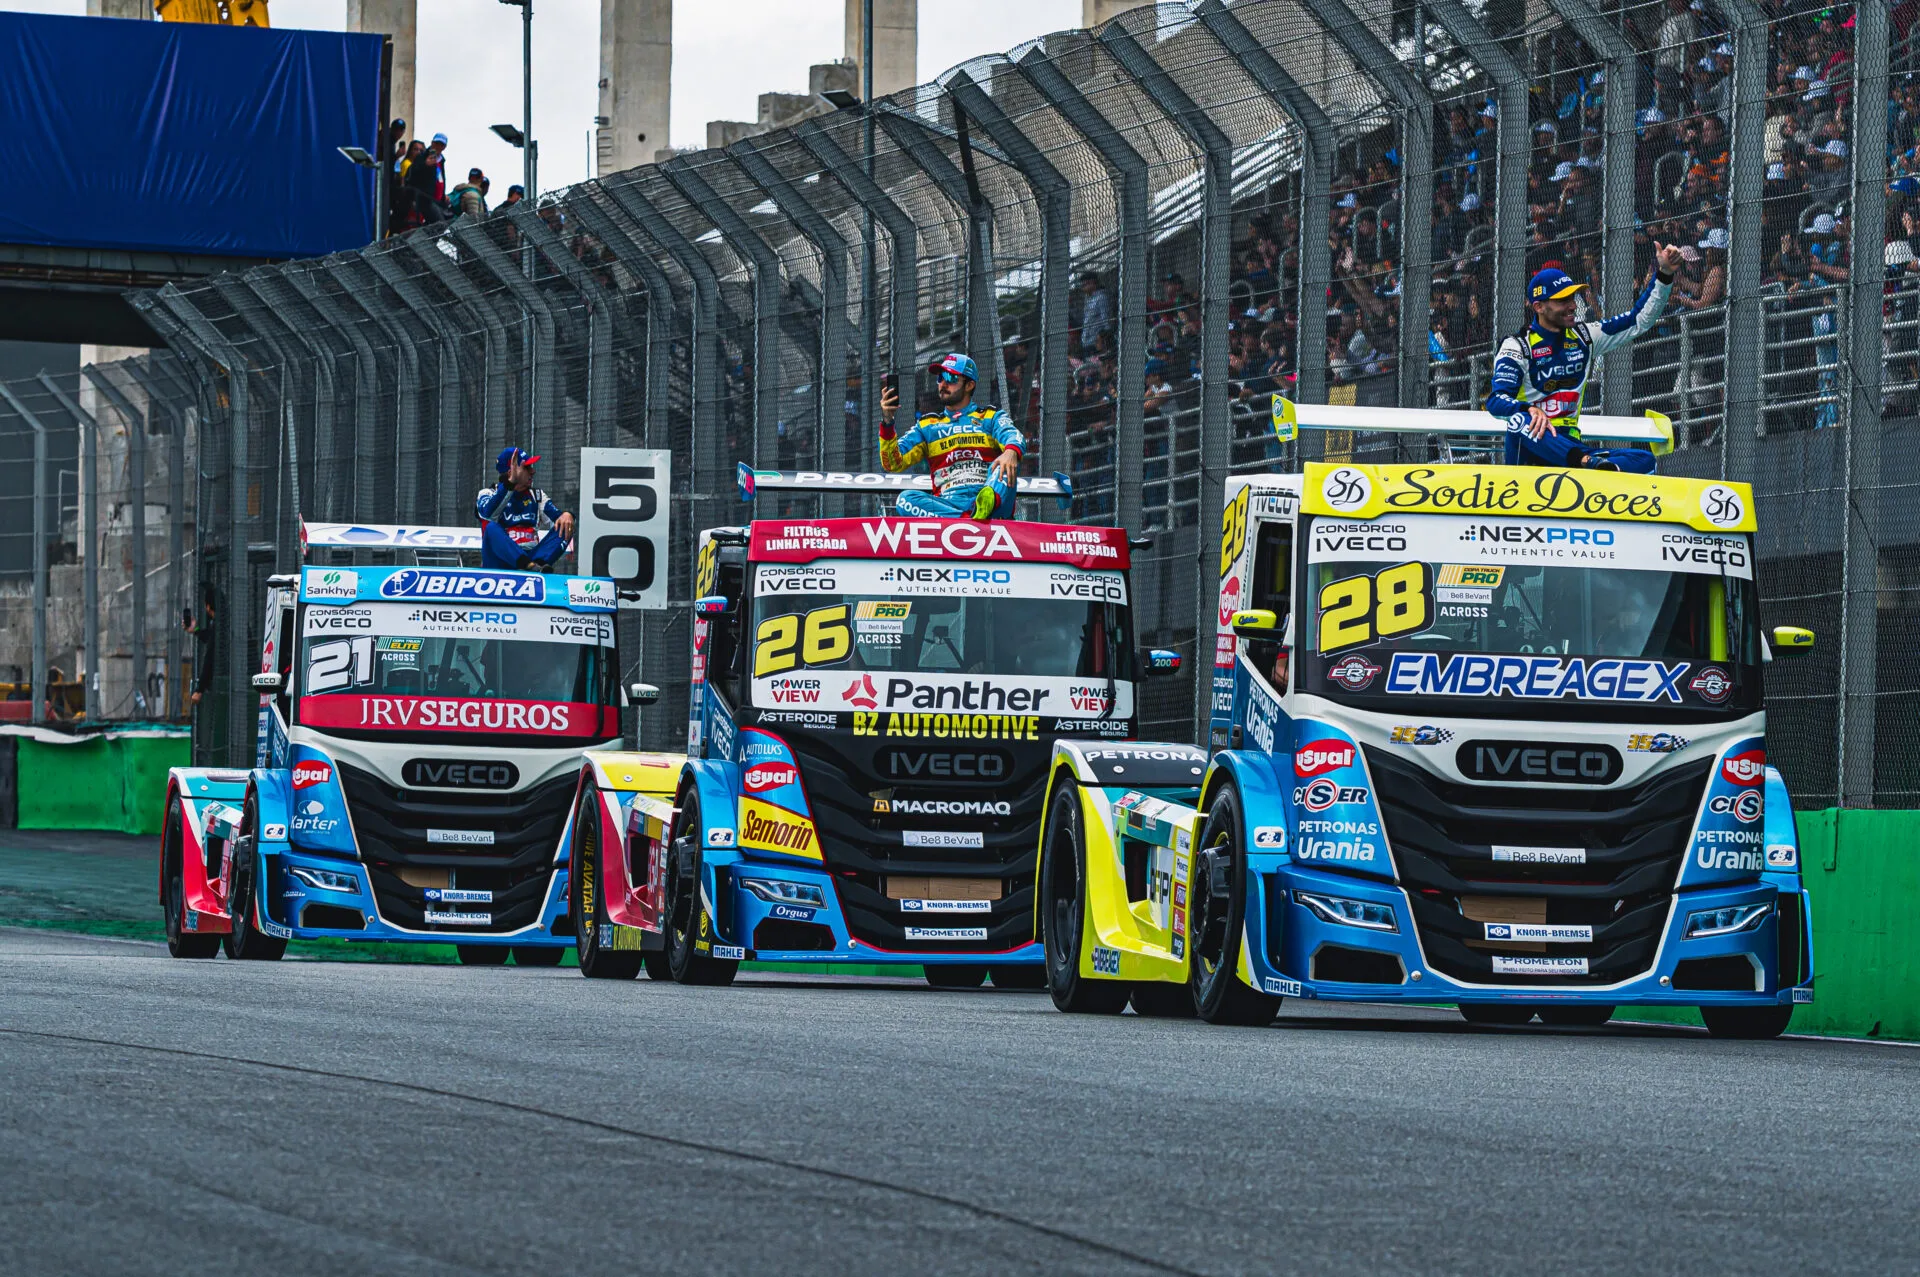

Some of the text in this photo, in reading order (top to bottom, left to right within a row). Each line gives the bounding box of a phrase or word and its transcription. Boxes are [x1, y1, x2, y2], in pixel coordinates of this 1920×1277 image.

[1532, 285, 1543, 297] 28
[1537, 361, 1584, 381] IVECO
[1387, 469, 1663, 518] Sodiê Doces
[783, 525, 829, 538] FILTROS
[1220, 484, 1252, 580] 28
[1315, 522, 1407, 534] CONSÓRCIO
[1479, 524, 1615, 546] NEXPRO
[392, 529, 482, 546] Kar
[766, 538, 848, 551] LINHA PESADA
[861, 518, 1023, 559] WEGA
[1056, 531, 1101, 544] FILTROS
[1316, 536, 1407, 552] IVECO
[1661, 534, 1745, 550] CONSÓRCIO
[1039, 542, 1118, 559] LINHA PESADA
[1480, 547, 1616, 560] AUTHENTIC VALUE
[1661, 546, 1746, 568] IVECO
[760, 566, 836, 577] CONSÓRCIO
[896, 567, 1011, 583] NEXPRO
[1050, 572, 1121, 585] CONSÓRCIO
[1460, 572, 1499, 584] PRO
[306, 586, 357, 597] Sankhya
[415, 576, 537, 598] IBIPORÃ
[760, 578, 836, 592] IVECO
[897, 586, 1011, 595] AUTHENTIC VALUE
[1050, 583, 1122, 599] IVECO
[569, 594, 616, 607] Sankhya
[695, 602, 725, 612] 00DEV
[309, 607, 372, 617] CONSÓRCIO
[874, 607, 907, 617] PRO
[1318, 561, 1430, 655] 28
[1439, 606, 1488, 618] ACROSS
[309, 617, 372, 629] IVECO
[422, 609, 517, 624] NEXPRO
[550, 616, 610, 628] CONSÓRCIO
[422, 625, 518, 635] AUTHENTIC VALUE
[550, 626, 610, 639] IVECO
[390, 642, 420, 650] ELITE
[754, 605, 852, 676] 26
[856, 634, 902, 644] ACROSS
[381, 653, 416, 662] ACROSS
[307, 635, 376, 697] 21
[771, 678, 821, 690] POWER
[1385, 652, 1691, 704] EMBREAGEX
[771, 690, 821, 703] VIEW
[885, 678, 1050, 712] Panther
[1069, 686, 1117, 698] POWE
[1211, 692, 1233, 711] IVECO
[1249, 677, 1279, 724] PETRONAS
[757, 710, 837, 724] ASTEROIDE
[853, 711, 1039, 741] BZ AUTOMOTIVE
[1054, 718, 1129, 731] ASTEROIDE
[1246, 698, 1275, 759] Urania
[711, 721, 731, 761] IVECO
[1085, 750, 1208, 762] PETRONA
[1296, 748, 1353, 772] usual
[1475, 746, 1609, 778] IVECO
[890, 751, 1004, 777] IVECO
[1725, 757, 1765, 781] usu
[415, 763, 510, 785] IVECO
[745, 769, 794, 789] usual
[892, 800, 1011, 816] MACROMAQ
[291, 816, 337, 830] Karter
[742, 809, 813, 851] Semorin
[1299, 820, 1378, 836] PETRONAS
[461, 834, 493, 843] BeVant
[920, 835, 982, 846] Be8 BeVant
[1298, 836, 1376, 861] Urania
[1512, 851, 1583, 864] Be8 BeVant
[1697, 846, 1764, 871] Urania
[443, 891, 491, 902] KNORR-BREMSE
[776, 905, 809, 919] Orgus
[926, 901, 990, 910] KNORR-BREMSE
[428, 911, 490, 920] PROMETEON
[265, 922, 291, 938] MAHLE
[908, 928, 984, 938] PROMETEON
[1516, 928, 1591, 938] KNORR-BREMSE
[713, 946, 744, 958] MAHLE
[1498, 956, 1583, 966] PROMETEON
[1265, 977, 1301, 995] MAHLE
